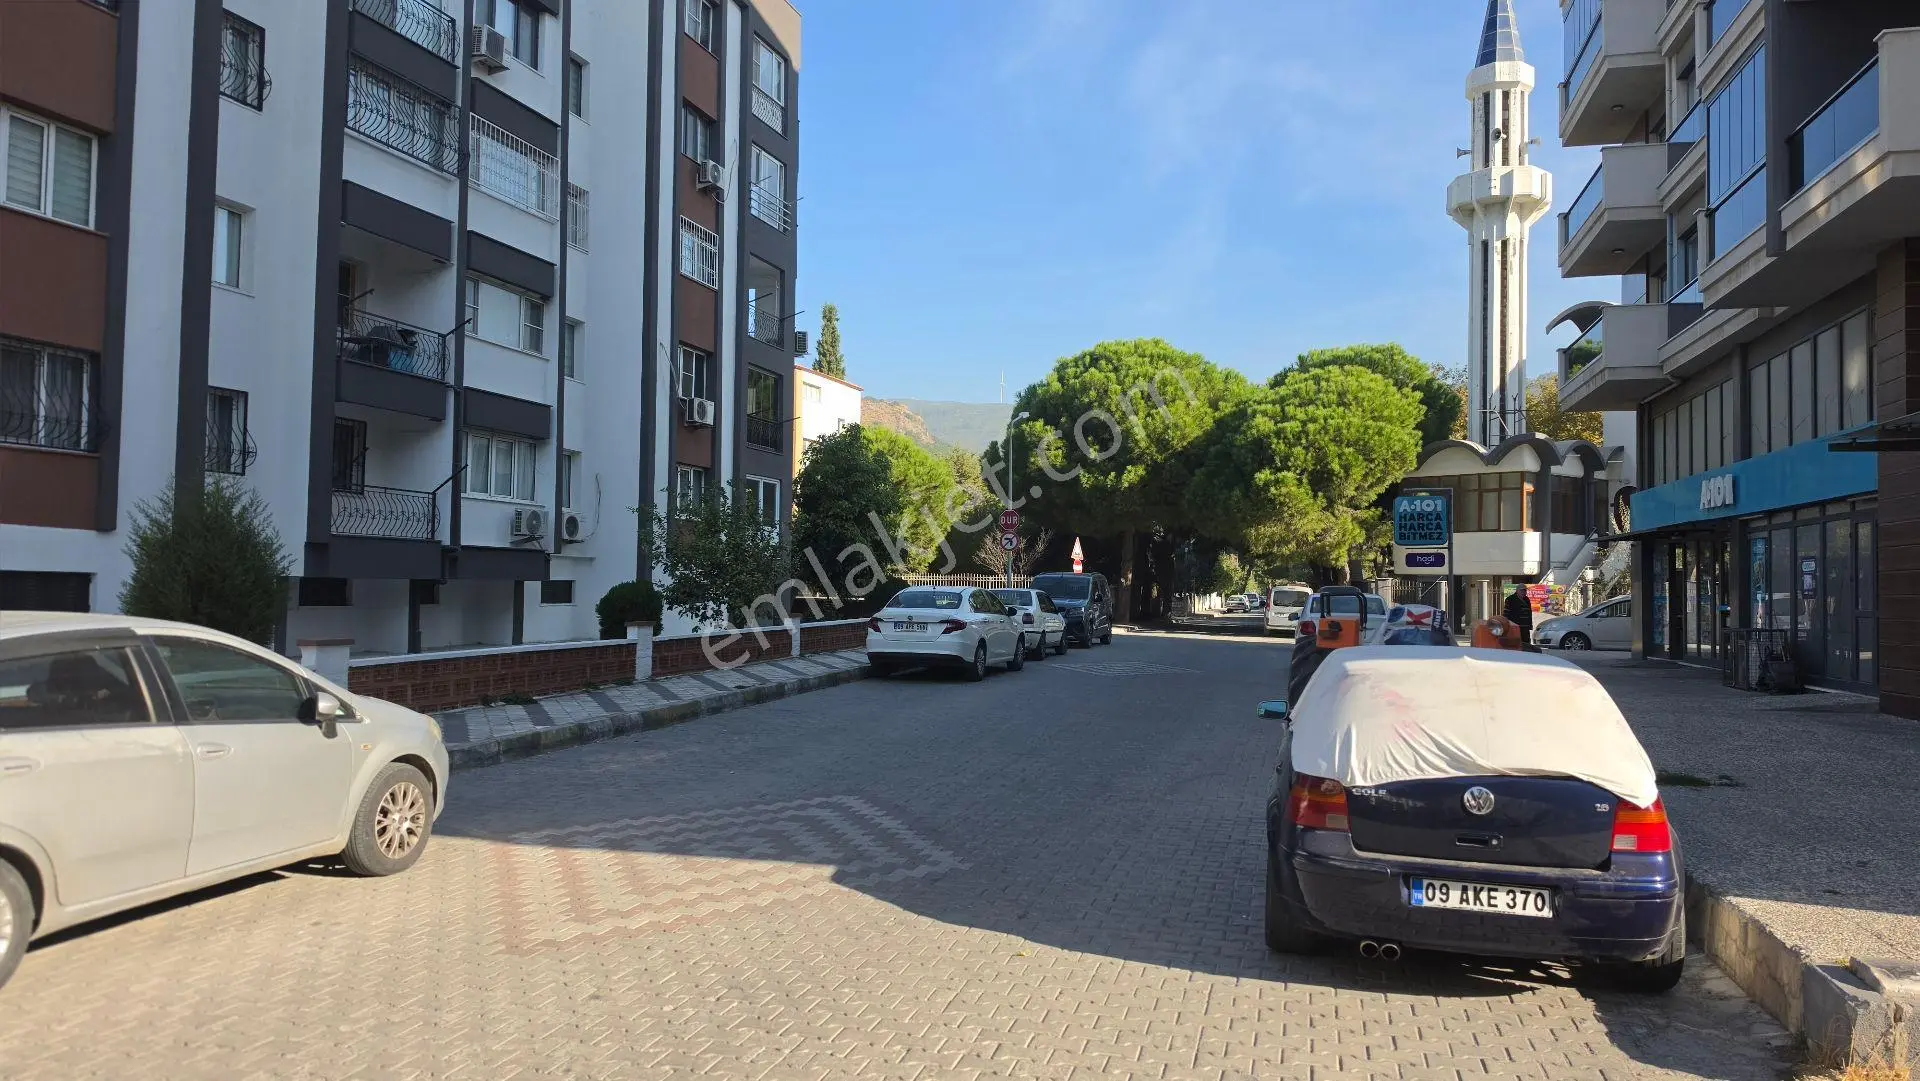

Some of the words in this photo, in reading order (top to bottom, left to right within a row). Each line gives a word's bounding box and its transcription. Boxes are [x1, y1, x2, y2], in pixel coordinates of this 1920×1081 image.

[1000, 516, 1018, 525] DUR
[1399, 512, 1443, 522] HARCA
[1399, 522, 1443, 532] HARCA
[1425, 882, 1450, 903] 09
[1459, 885, 1499, 908] AKE
[1505, 889, 1546, 912] 370
